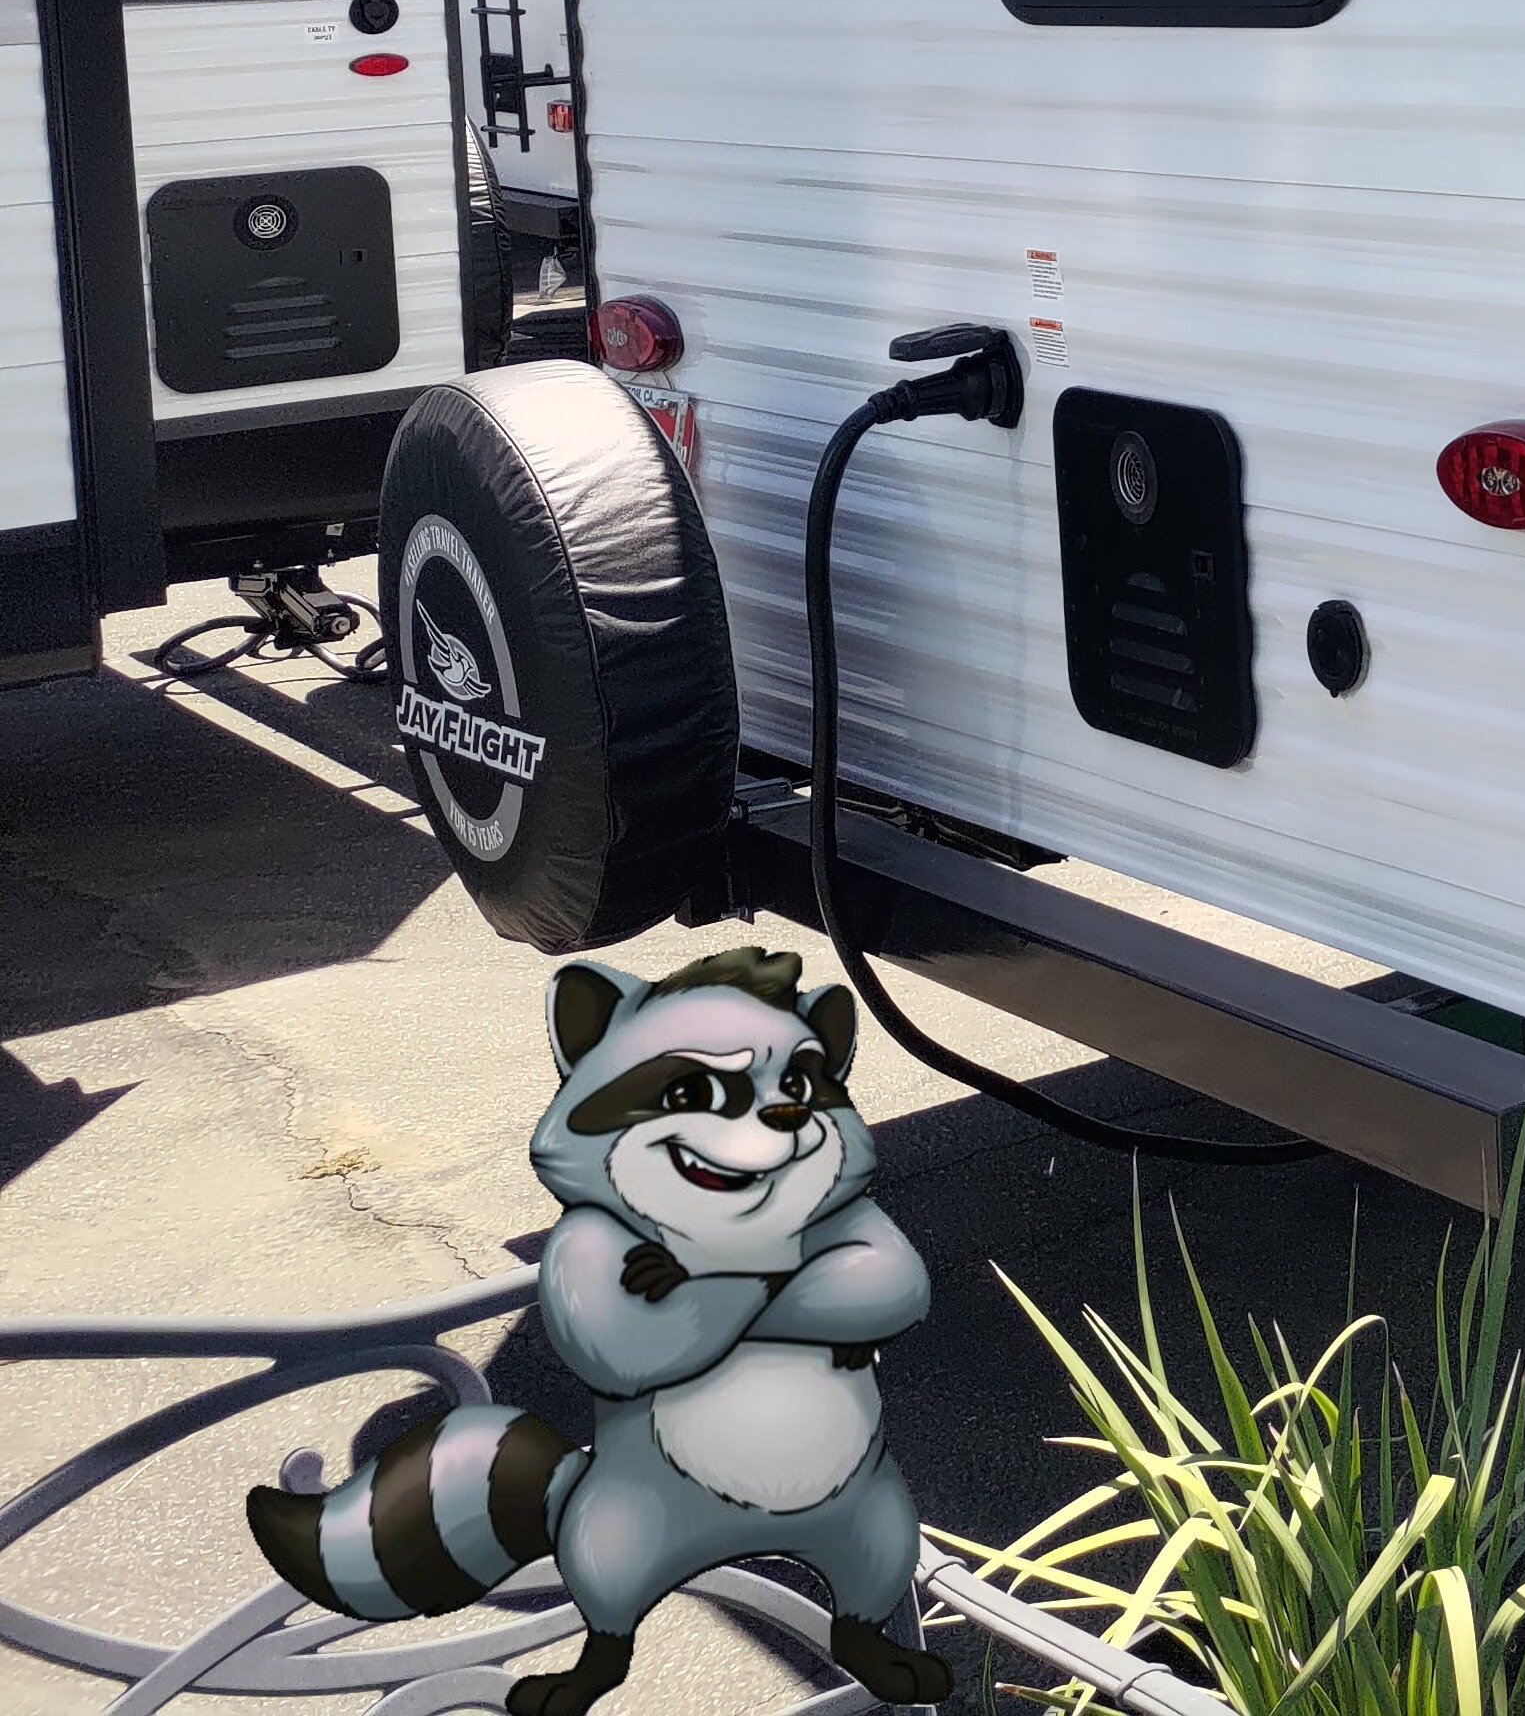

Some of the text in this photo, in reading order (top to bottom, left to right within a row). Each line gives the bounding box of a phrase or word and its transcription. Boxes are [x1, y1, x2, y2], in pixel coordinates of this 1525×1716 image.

[430, 525, 460, 563] TRAVEL
[461, 546, 495, 625] TRAILER
[396, 684, 546, 780] JAY FLIGHT
[450, 799, 467, 840] FOR
[476, 820, 504, 851] YEARS
